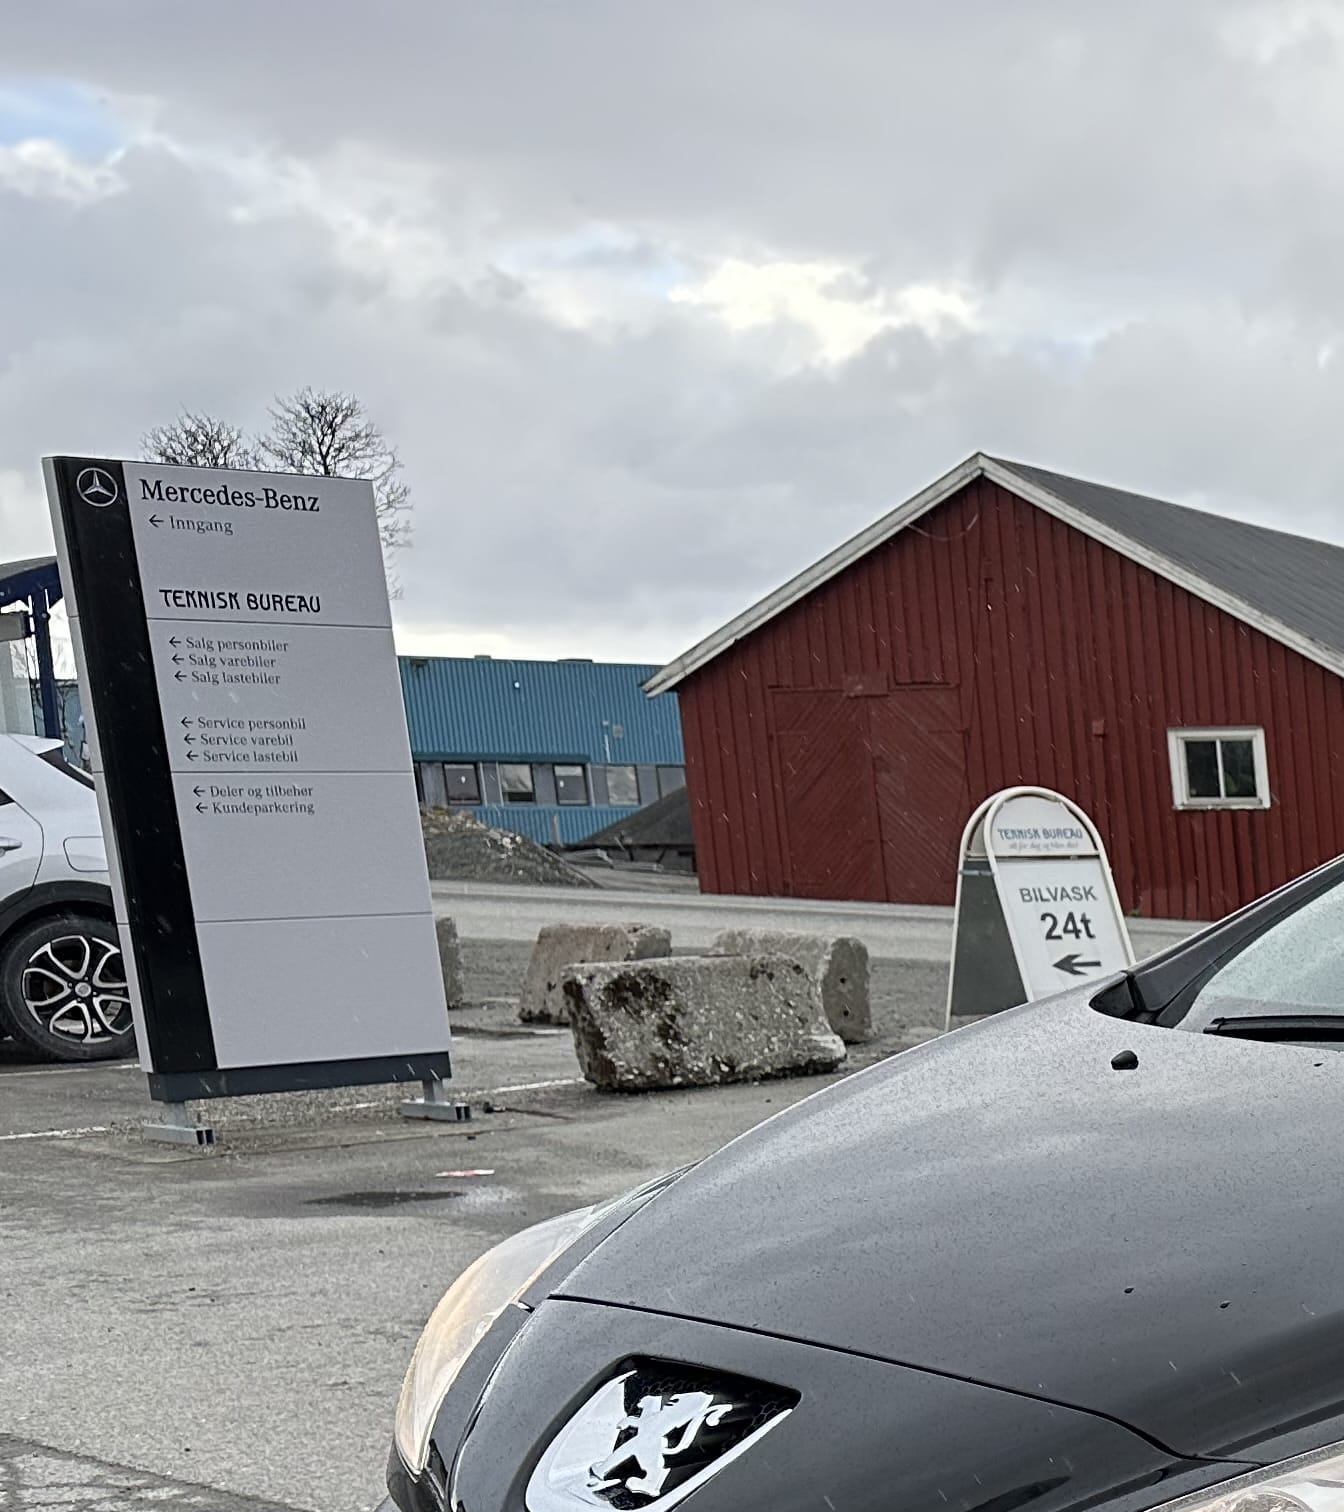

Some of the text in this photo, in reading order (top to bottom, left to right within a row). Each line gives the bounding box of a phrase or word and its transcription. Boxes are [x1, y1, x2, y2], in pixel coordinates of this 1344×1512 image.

[139, 478, 321, 512] Mercedes-Benz
[169, 515, 234, 536] Inngang
[246, 593, 322, 613] BUREAU
[185, 636, 289, 653] Salg personbiler
[188, 653, 277, 669] Salg varebiler
[191, 670, 281, 686] Salg lastebiler
[197, 716, 307, 732] Service personbil
[200, 733, 294, 746] Service varebil
[203, 750, 299, 763] Service lastebil
[209, 785, 244, 798] Deler
[247, 788, 263, 799] og
[212, 801, 315, 817] Kundeparkering
[1019, 886, 1097, 902] BILVASK
[1040, 911, 1097, 941] 24t
